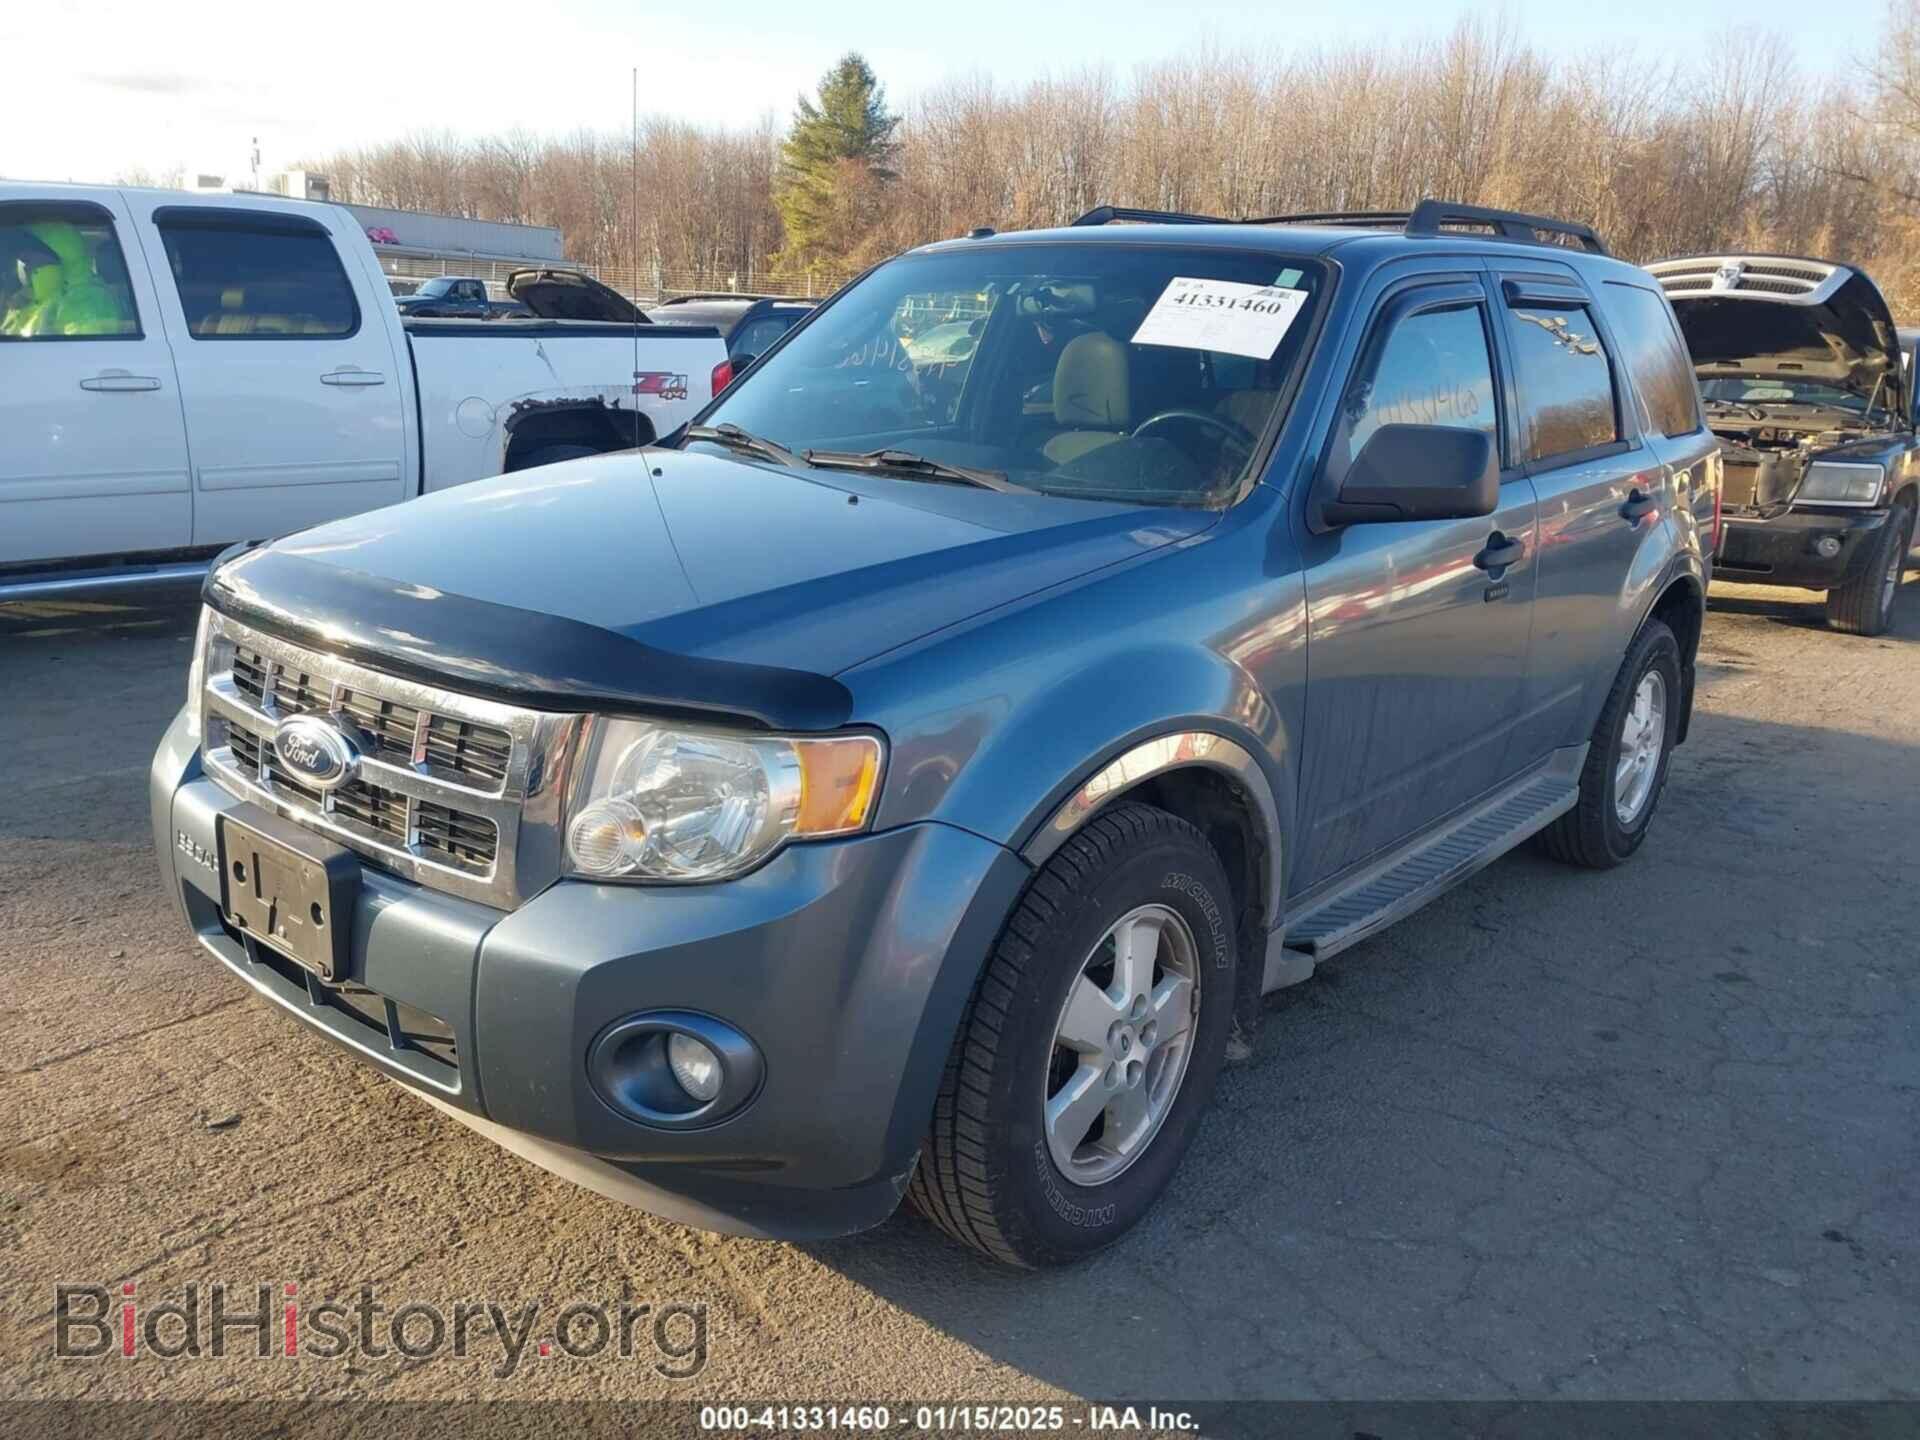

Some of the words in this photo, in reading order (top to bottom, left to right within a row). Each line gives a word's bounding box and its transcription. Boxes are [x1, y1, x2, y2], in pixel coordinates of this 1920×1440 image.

[1173, 292, 1282, 316] 41331460
[284, 733, 320, 769] Ford
[177, 829, 219, 873] ESCAP
[1160, 872, 1229, 969] MICHELIN
